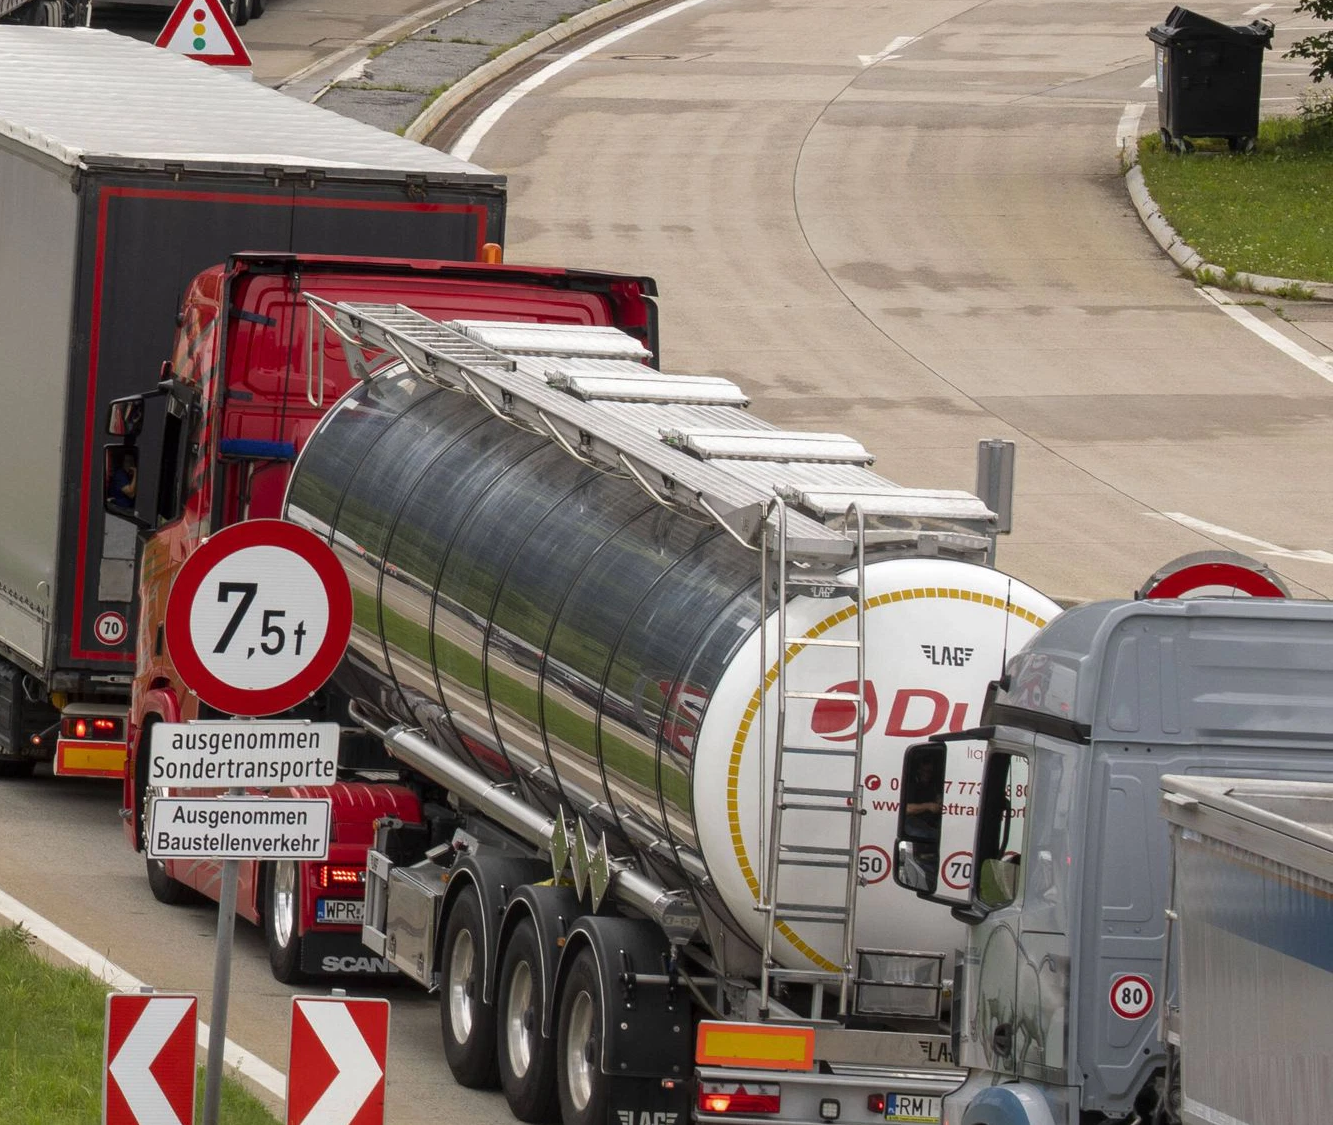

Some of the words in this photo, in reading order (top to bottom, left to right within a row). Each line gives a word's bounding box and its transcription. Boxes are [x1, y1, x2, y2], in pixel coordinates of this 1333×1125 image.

[103, 621, 120, 635] 70
[172, 732, 320, 755] ausgenommen
[152, 756, 334, 782] Sondertransporte
[172, 805, 308, 829] Ausgenommen
[156, 831, 321, 852] Baustellenverkehr
[1122, 987, 1143, 1006] 80
